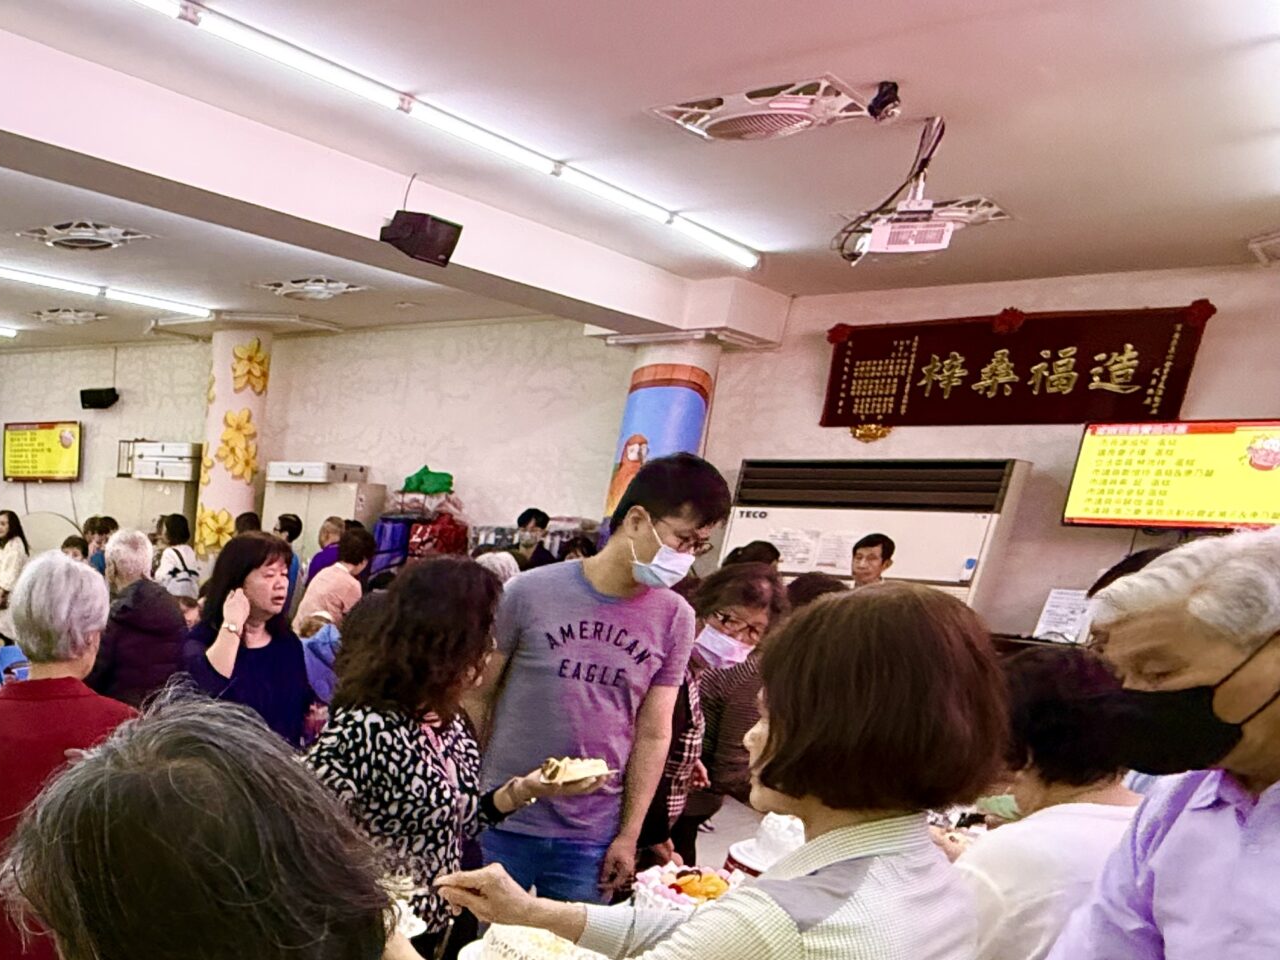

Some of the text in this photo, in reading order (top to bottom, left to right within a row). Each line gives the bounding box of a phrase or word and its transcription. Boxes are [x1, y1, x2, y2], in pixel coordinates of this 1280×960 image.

[917, 343, 1142, 399] 造福桑梓
[738, 510, 768, 519] TECO
[545, 620, 651, 665] AMERICAN
[558, 658, 626, 687] EAGLE
